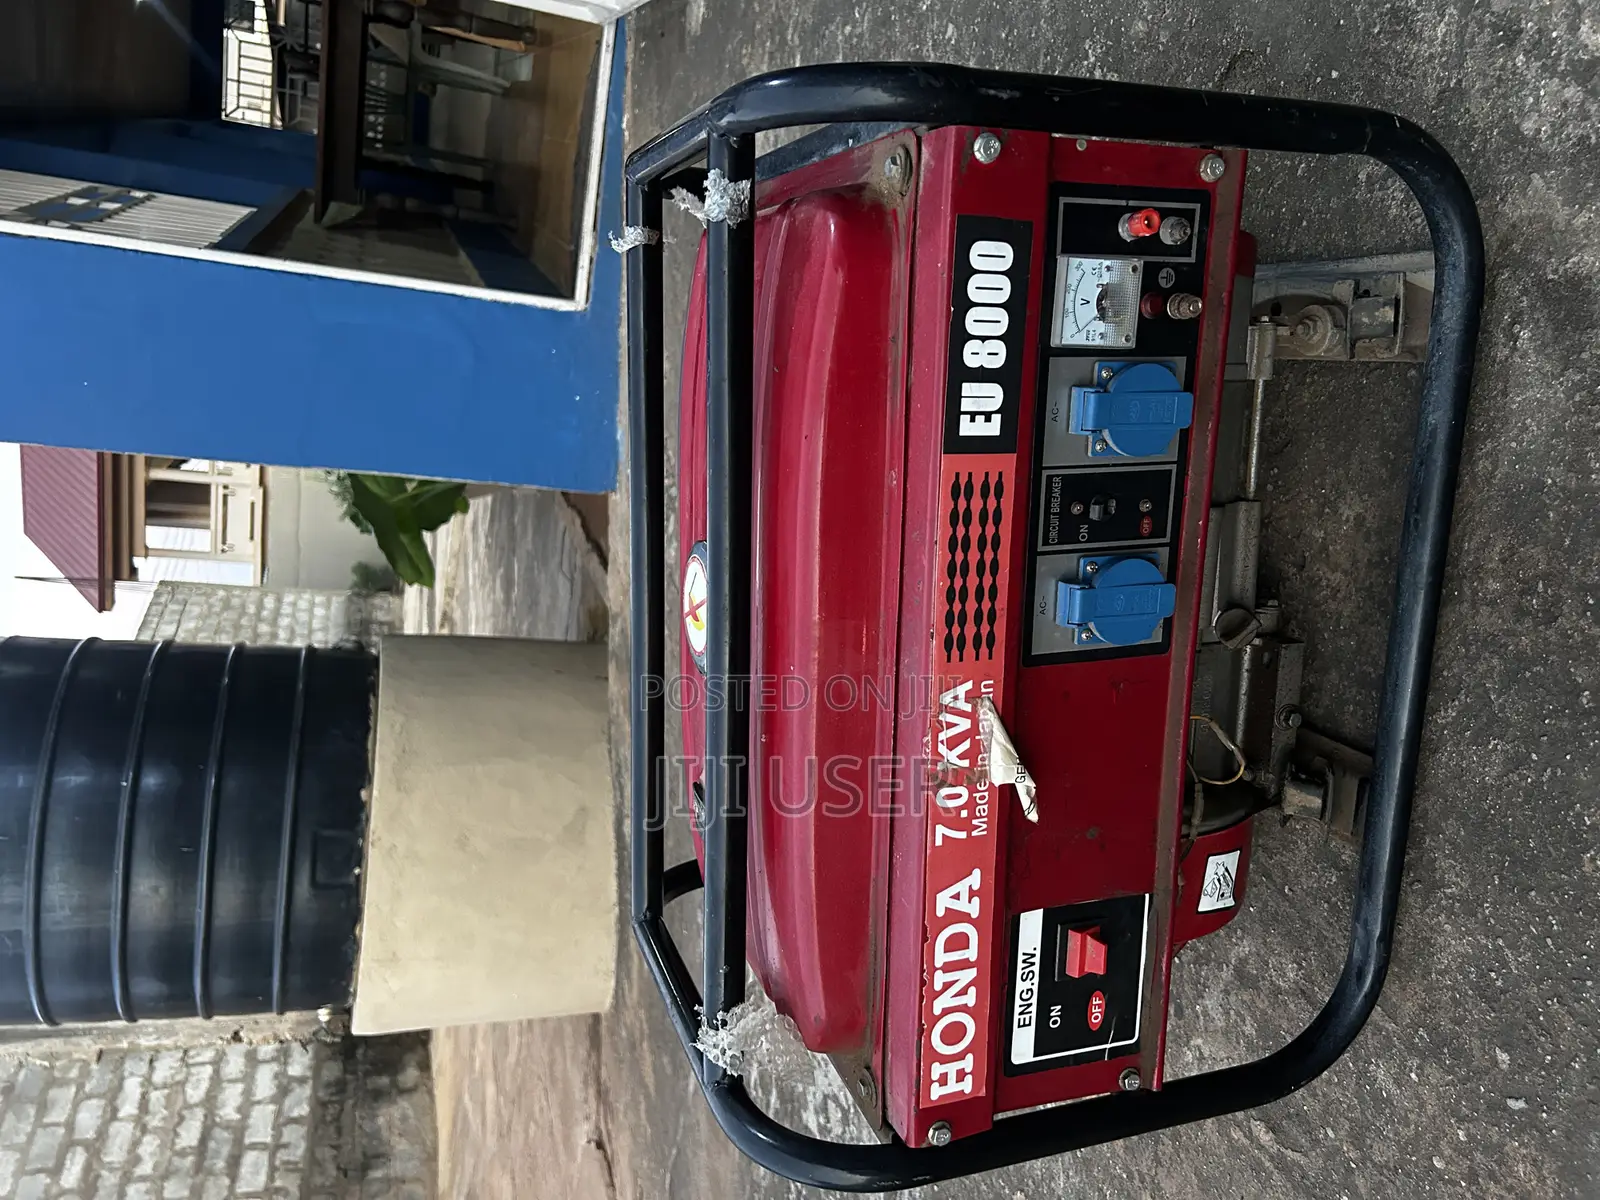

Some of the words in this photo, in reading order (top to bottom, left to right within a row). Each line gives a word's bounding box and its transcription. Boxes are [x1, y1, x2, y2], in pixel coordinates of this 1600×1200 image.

[1074, 261, 1083, 271] 300
[963, 240, 1014, 369] 8000
[1080, 298, 1090, 306] V
[959, 382, 1004, 436] EU
[1050, 476, 1062, 513] BREAKER
[1049, 514, 1060, 544] CIRCUIT
[1079, 524, 1089, 542] ON
[1142, 518, 1150, 533] OFF
[937, 679, 973, 768] KVA
[935, 785, 969, 847] 7.0
[971, 777, 990, 837] Made
[930, 867, 982, 1100] HONDA
[1017, 946, 1037, 1028] ENG.SW.
[1049, 1004, 1062, 1028] ON
[1091, 996, 1102, 1023] OFF
